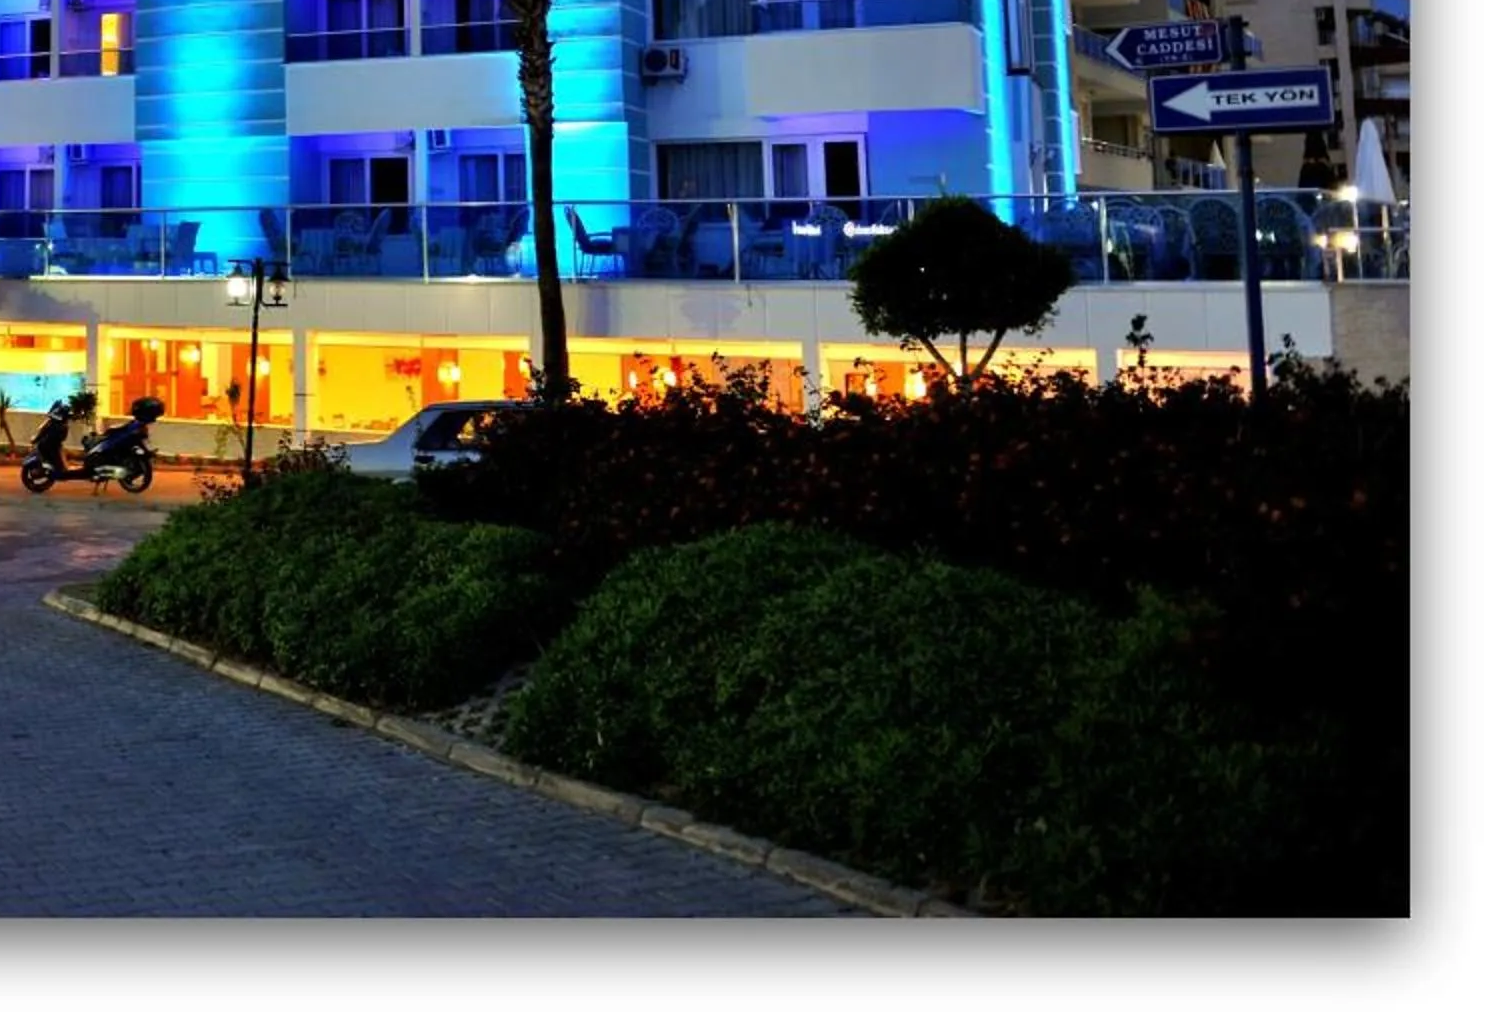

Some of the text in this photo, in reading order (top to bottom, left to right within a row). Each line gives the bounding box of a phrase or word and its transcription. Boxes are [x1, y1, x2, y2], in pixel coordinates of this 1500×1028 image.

[1143, 25, 1202, 41] MESUT
[1211, 87, 1315, 106] TEK YÖN
